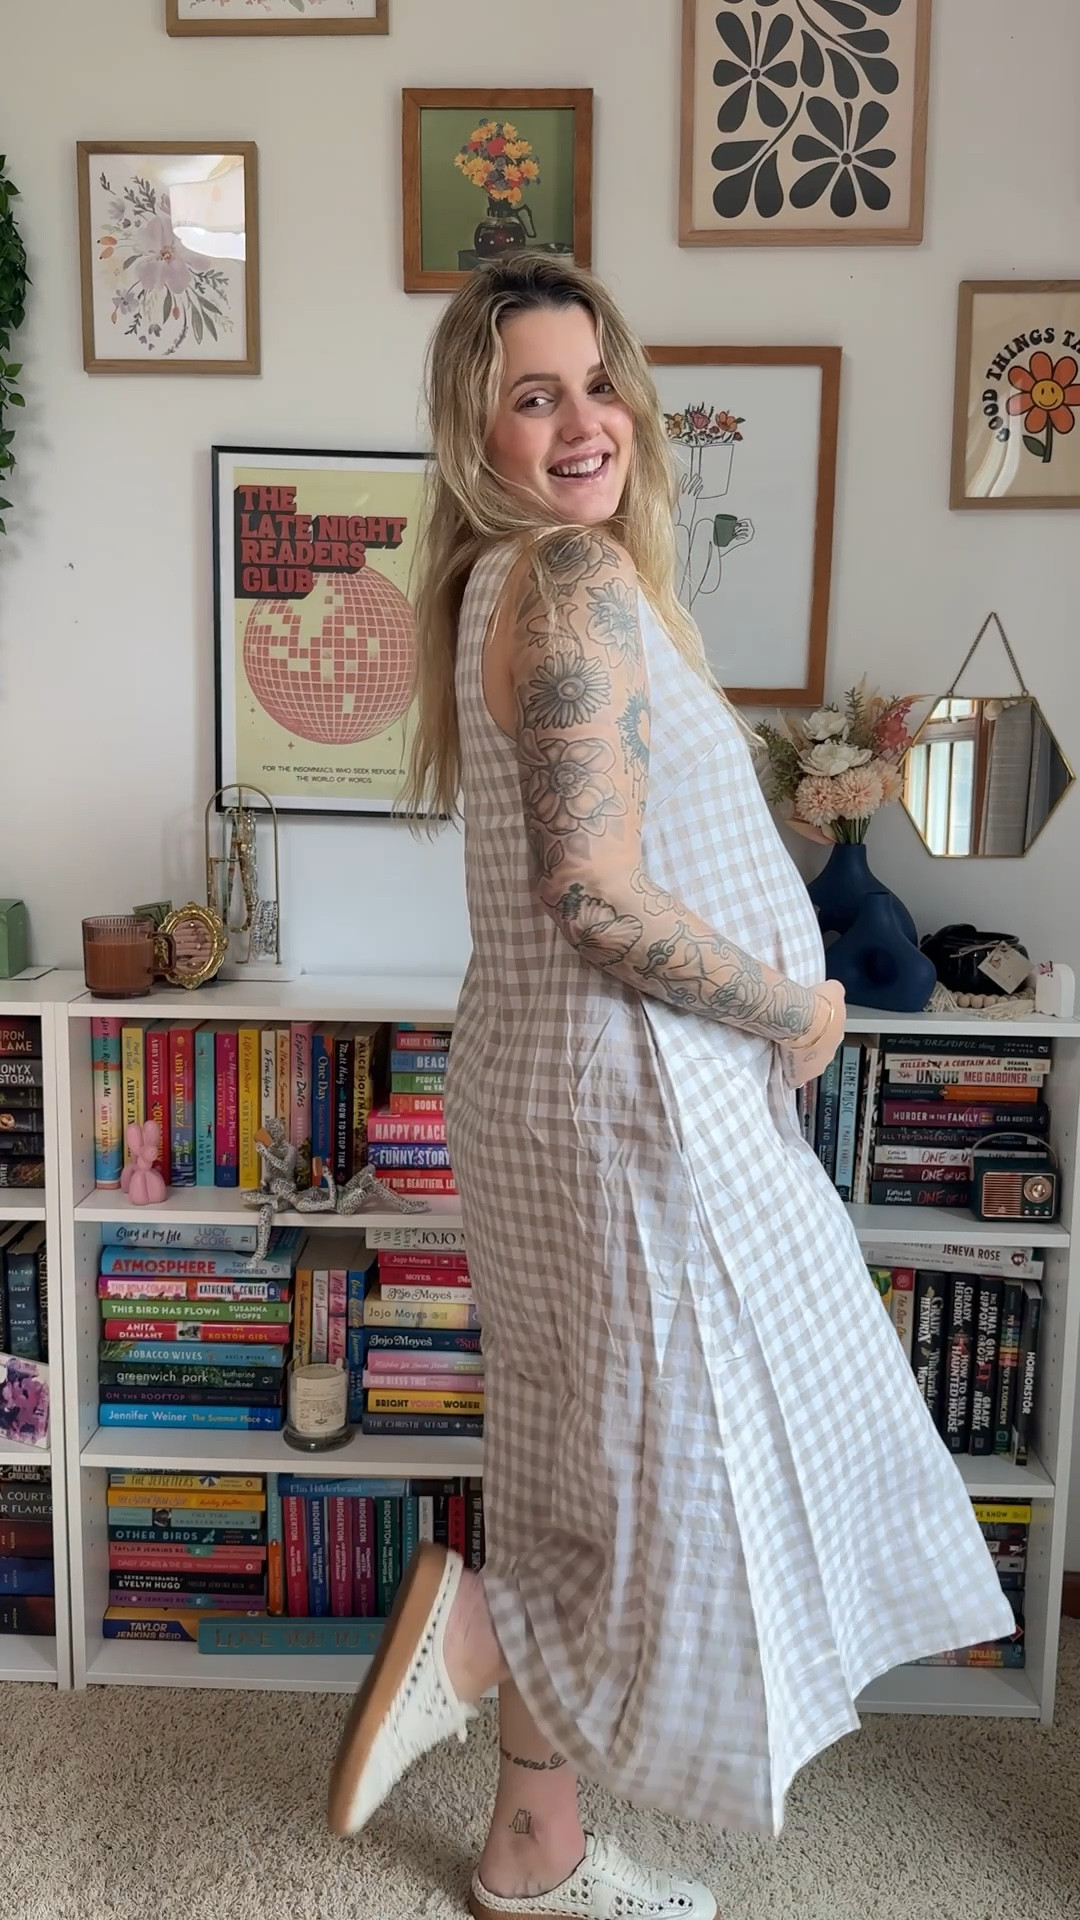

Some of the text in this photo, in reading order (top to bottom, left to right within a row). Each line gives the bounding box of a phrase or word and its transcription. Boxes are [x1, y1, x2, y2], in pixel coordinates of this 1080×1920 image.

[982, 327, 1056, 442] GOOD THINGS
[238, 485, 298, 512] THE
[240, 513, 408, 543] LATE NIGHT
[241, 540, 366, 568] READERS
[242, 568, 314, 593] CLUB
[262, 765, 397, 776] FOR THE INSOMNIACS WHO SEEK REFUGE
[296, 775, 373, 785] THE WORLD OF WORDS
[923, 1038, 977, 1049] DREADFUL
[1, 1063, 32, 1075] ONYX
[151, 1038, 161, 1096] ABBY JIMENEZ
[899, 1060, 931, 1069] KILLERS
[951, 1059, 986, 1068] CERTAIN
[987, 1058, 1002, 1067] AGE
[315, 1055, 328, 1101] One Day
[335, 1065, 349, 1084] Haig
[915, 1069, 1028, 1085] UNSUB MEG GARDINER
[174, 1051, 184, 1128] ABBY JIMENEZ
[243, 1072, 252, 1093] Short
[356, 1042, 366, 1127] ALICE HOFFMAN
[841, 1061, 858, 1115] THEME MUSIC
[126, 1076, 135, 1105] ABBY
[295, 1081, 308, 1108] Dates
[414, 1099, 437, 1111] BOOK
[822, 1066, 834, 1141] WOMAN IN CABIN 10
[892, 1111, 928, 1122] MURDER
[947, 1112, 979, 1123] FAMILY
[337, 1102, 346, 1168] HOW TO STOP TIME
[375, 1123, 446, 1141] HAPPY PLACE
[379, 1149, 450, 1166] FUNNY STORY
[921, 1150, 948, 1164] ONE
[921, 1168, 946, 1181] ONE
[406, 1178, 444, 1189] BEAUTIFUL
[916, 1190, 945, 1204] ONE
[152, 1230, 165, 1243] my
[198, 1227, 227, 1237] LUCY
[417, 1231, 457, 1245] JOJO
[193, 1236, 232, 1246] SCORE
[941, 1243, 975, 1259] JENEVA
[977, 1247, 1001, 1262] ROSE
[111, 1258, 216, 1274] ATMOSPHERE
[392, 1256, 432, 1265] Jojo Moyes
[405, 1273, 431, 1281] MOYES
[239, 1285, 266, 1296] CENTER
[387, 1287, 452, 1302] Jojo Moyes
[111, 1305, 221, 1316] THIS BIRD HAS FLOWN
[228, 1304, 267, 1313] SUSANNA
[952, 1281, 964, 1326] HENDRIX
[963, 1286, 974, 1322] GRADY
[368, 1307, 427, 1319] Jojo Moyes
[917, 1296, 932, 1344] HENDRIX
[126, 1322, 155, 1331] ANITA
[975, 1290, 990, 1366] SUPPORT GROUP
[984, 1306, 998, 1362] FINAL GIRL
[118, 1331, 163, 1339] DIAMANT
[207, 1331, 269, 1340] BOSTON GIRL
[368, 1334, 433, 1348] Jojo Moyes
[128, 1349, 203, 1361] TOBACCO WIVES
[999, 1314, 1015, 1425] MY EXORCISM
[117, 1370, 208, 1385] greenwich park
[1021, 1351, 1036, 1415] HORRORSTÖR
[106, 1392, 186, 1401] ON ROOFTOP
[947, 1345, 962, 1433] HAUNTED HOUSE
[956, 1354, 969, 1427] HOW TO SELL A
[375, 1399, 409, 1408] BRIGHT
[443, 1400, 481, 1409] WOMEN
[971, 1390, 983, 1431] HENDRIX
[108, 1409, 261, 1423] Jennifer Weiner The Place
[980, 1396, 992, 1428] GRADY
[385, 1419, 449, 1429] CHRISTIE AFFAIR
[131, 1475, 195, 1488] THE JETSETTERS
[290, 1483, 362, 1493] Elin Hilderbrand
[7, 1491, 45, 1501] COURT
[289, 1496, 298, 1541] BRIDGERTON
[311, 1500, 321, 1545] BRIDGERTON
[336, 1496, 346, 1542] BRIDGERTON
[358, 1497, 367, 1543] BRIDGERTON
[383, 1500, 392, 1545] BRIDGERTON
[115, 1530, 198, 1541] OTHER BIRDS
[118, 1580, 153, 1588] EVELYN
[155, 1581, 181, 1590] HUGO
[129, 1622, 168, 1632] TAYLOR
[115, 1631, 182, 1640] JENKINS REID
[215, 1628, 276, 1649] LOVE
[282, 1629, 326, 1649] YOU
